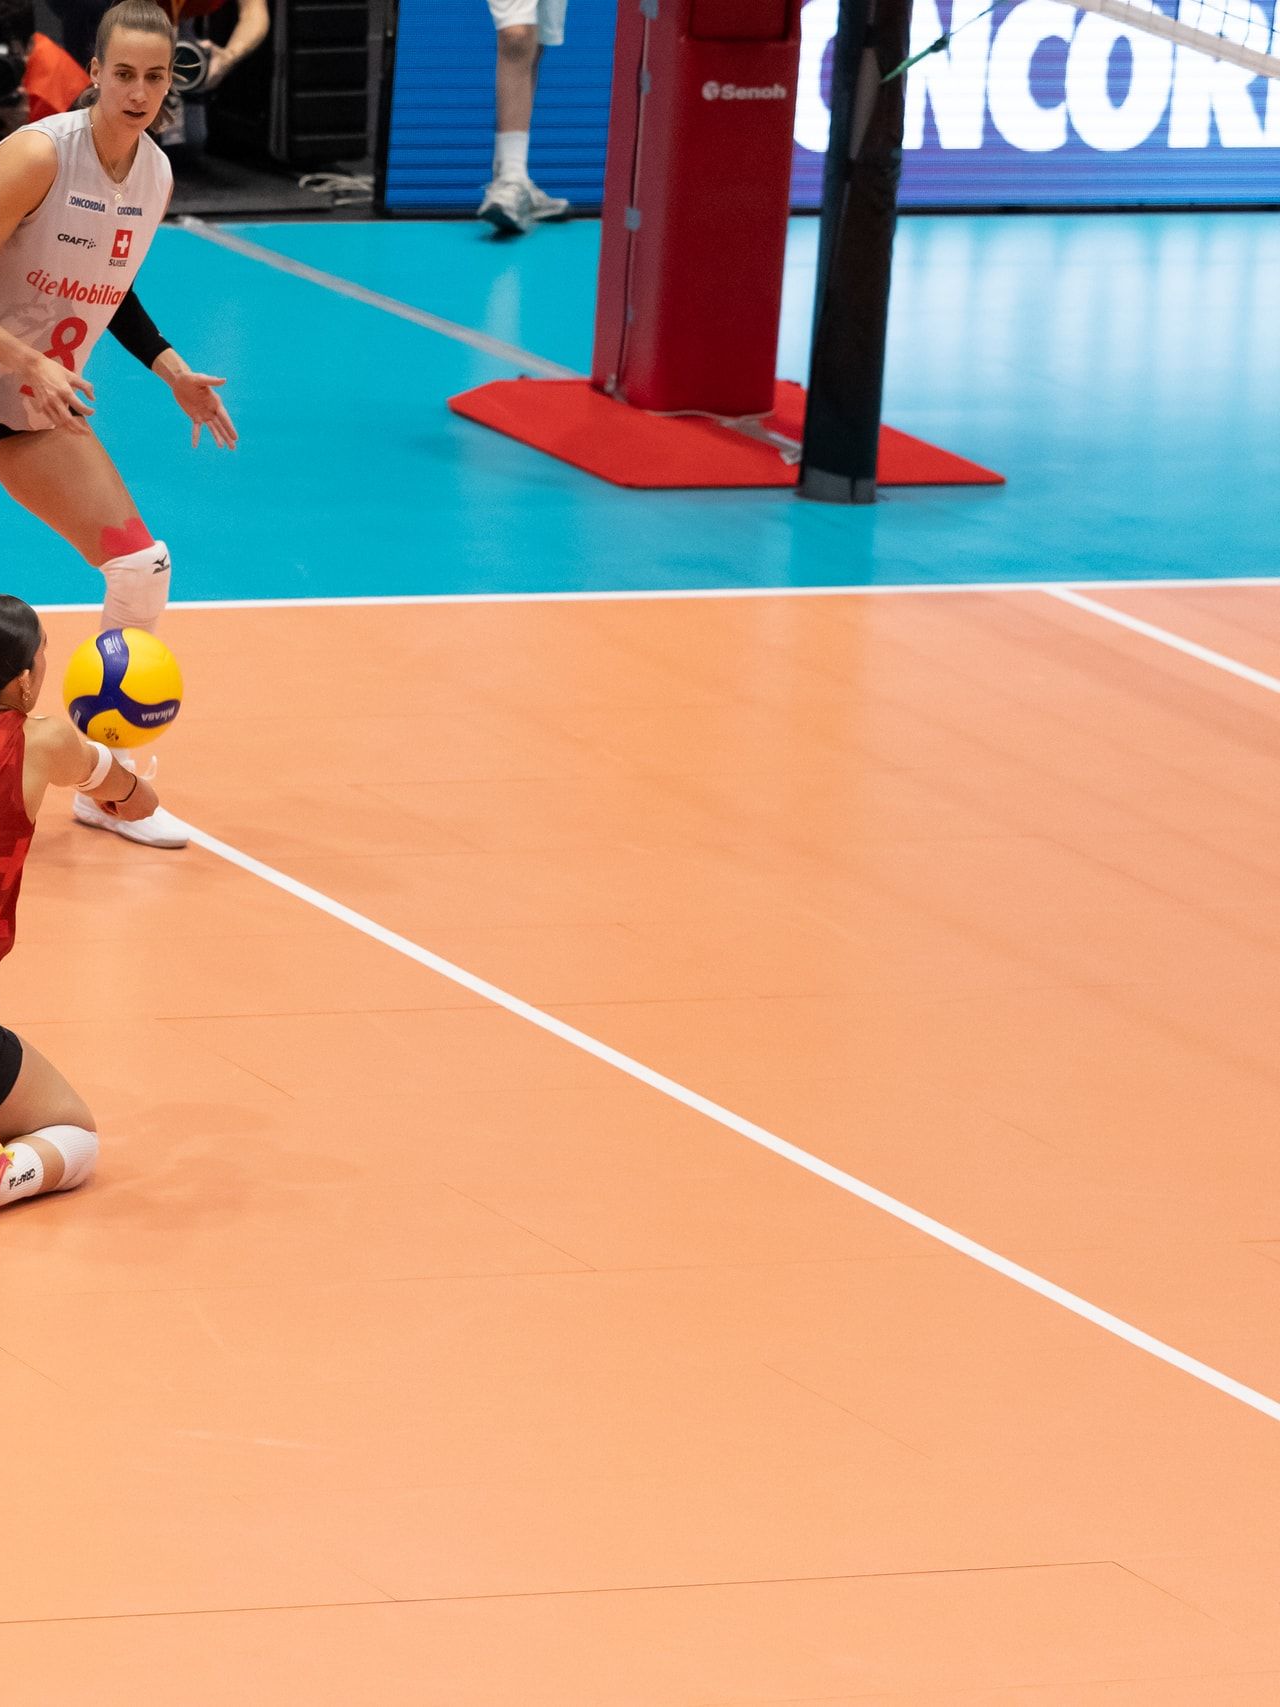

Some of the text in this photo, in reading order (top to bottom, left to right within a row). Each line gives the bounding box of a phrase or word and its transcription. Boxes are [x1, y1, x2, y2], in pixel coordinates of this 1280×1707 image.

[793, 0, 1280, 151] NCOR
[721, 83, 787, 100] Senoh
[68, 195, 106, 213] ONCORDIA
[57, 233, 89, 248] CRAFT
